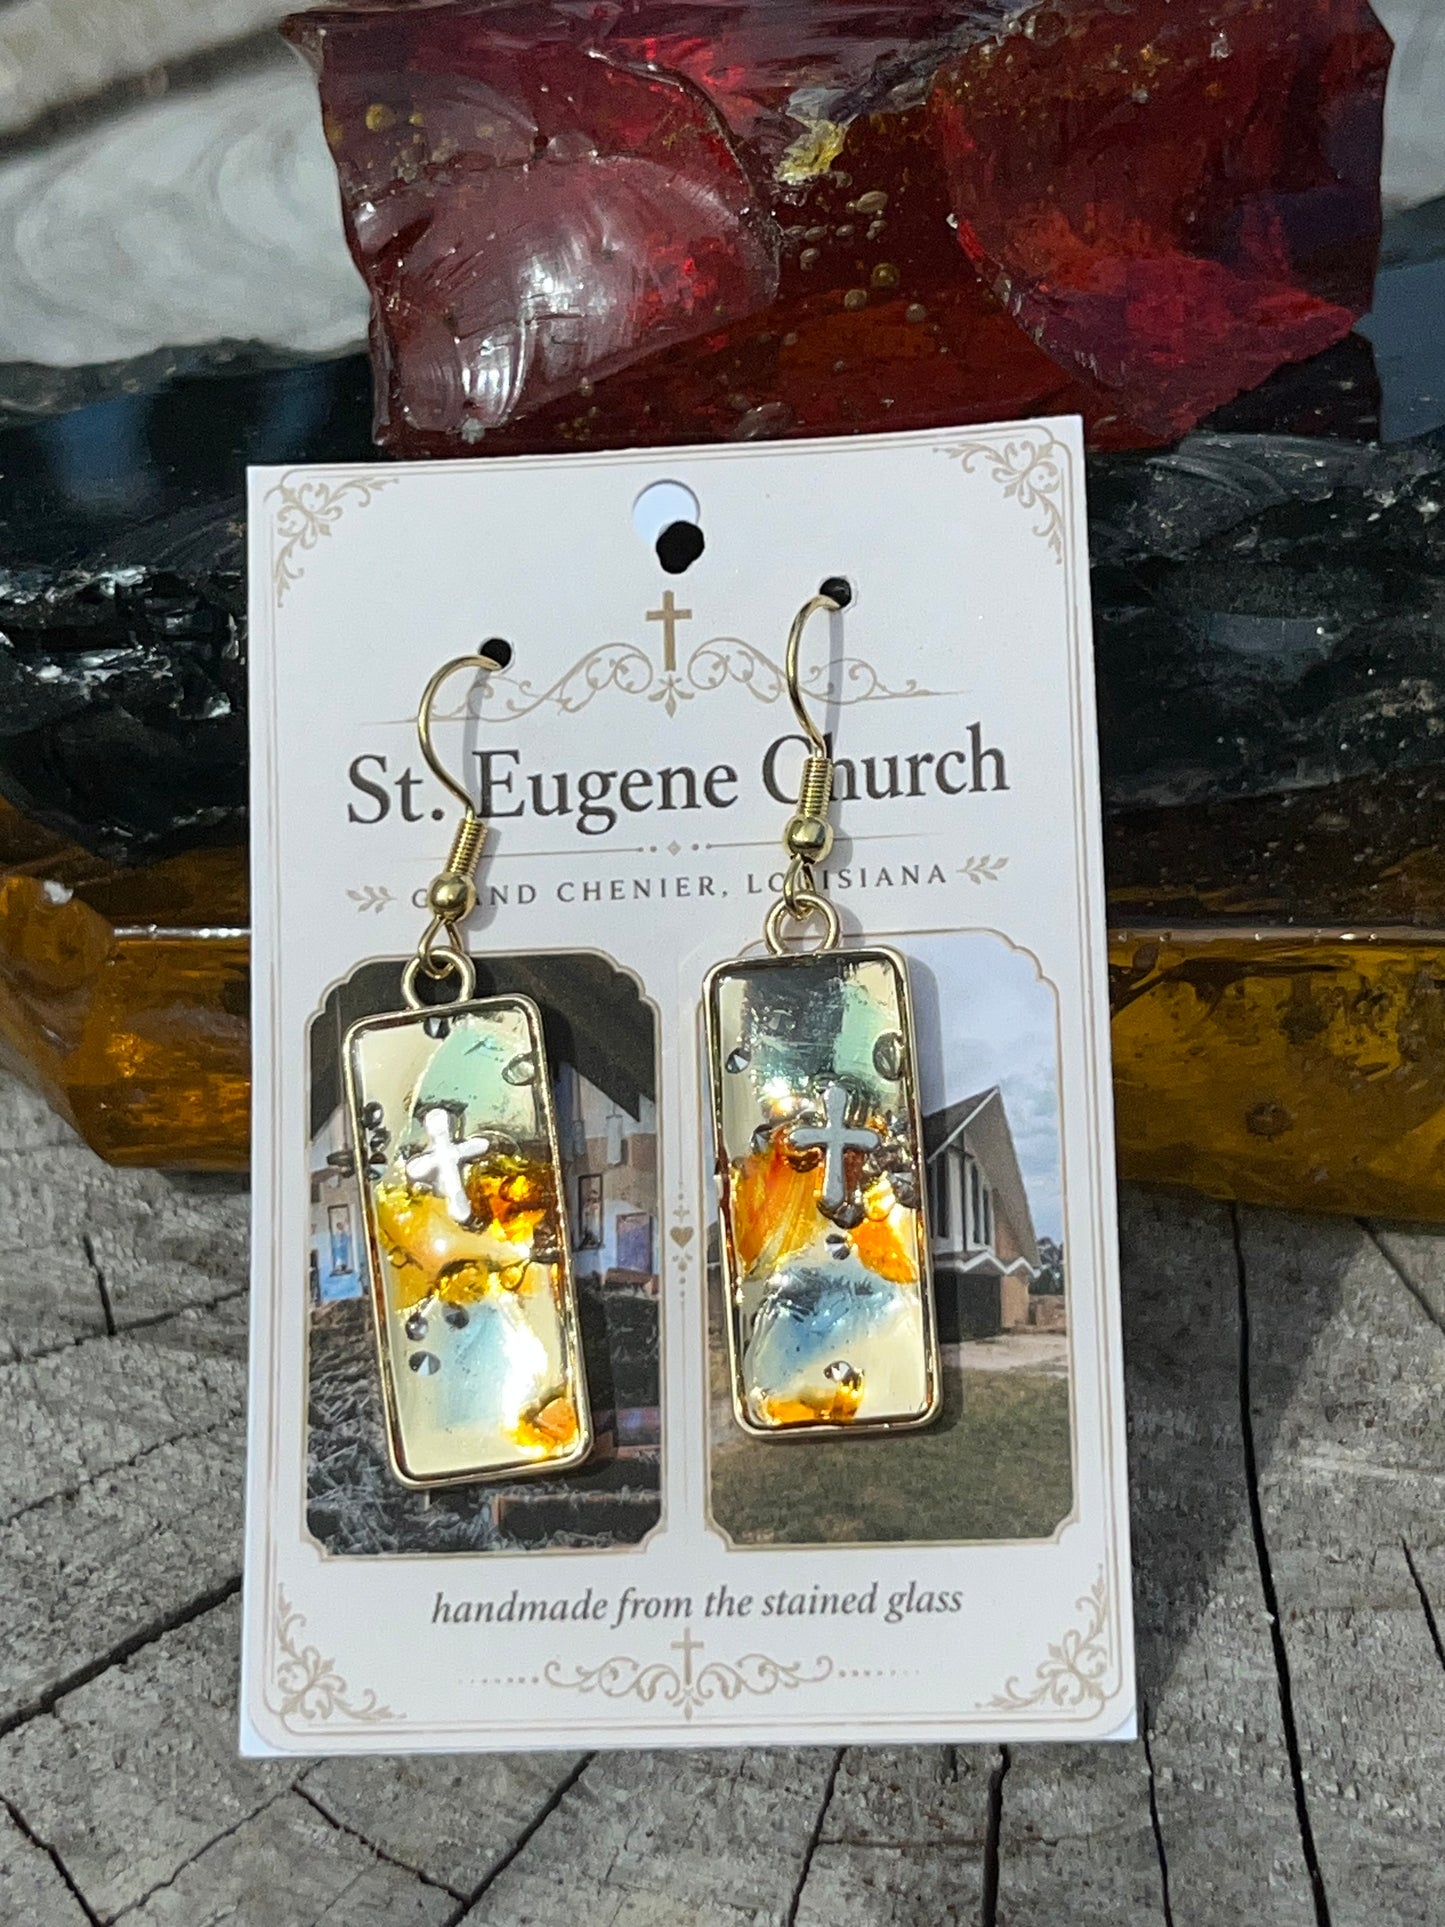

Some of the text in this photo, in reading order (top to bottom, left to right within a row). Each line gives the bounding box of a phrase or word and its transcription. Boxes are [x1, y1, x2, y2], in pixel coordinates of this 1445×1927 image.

[347, 721, 1010, 835] St. Eugene Church
[557, 875, 728, 903] CHENIER,
[747, 864, 946, 894] LOISIANA
[431, 1580, 963, 1630] handmade from the stained glass
